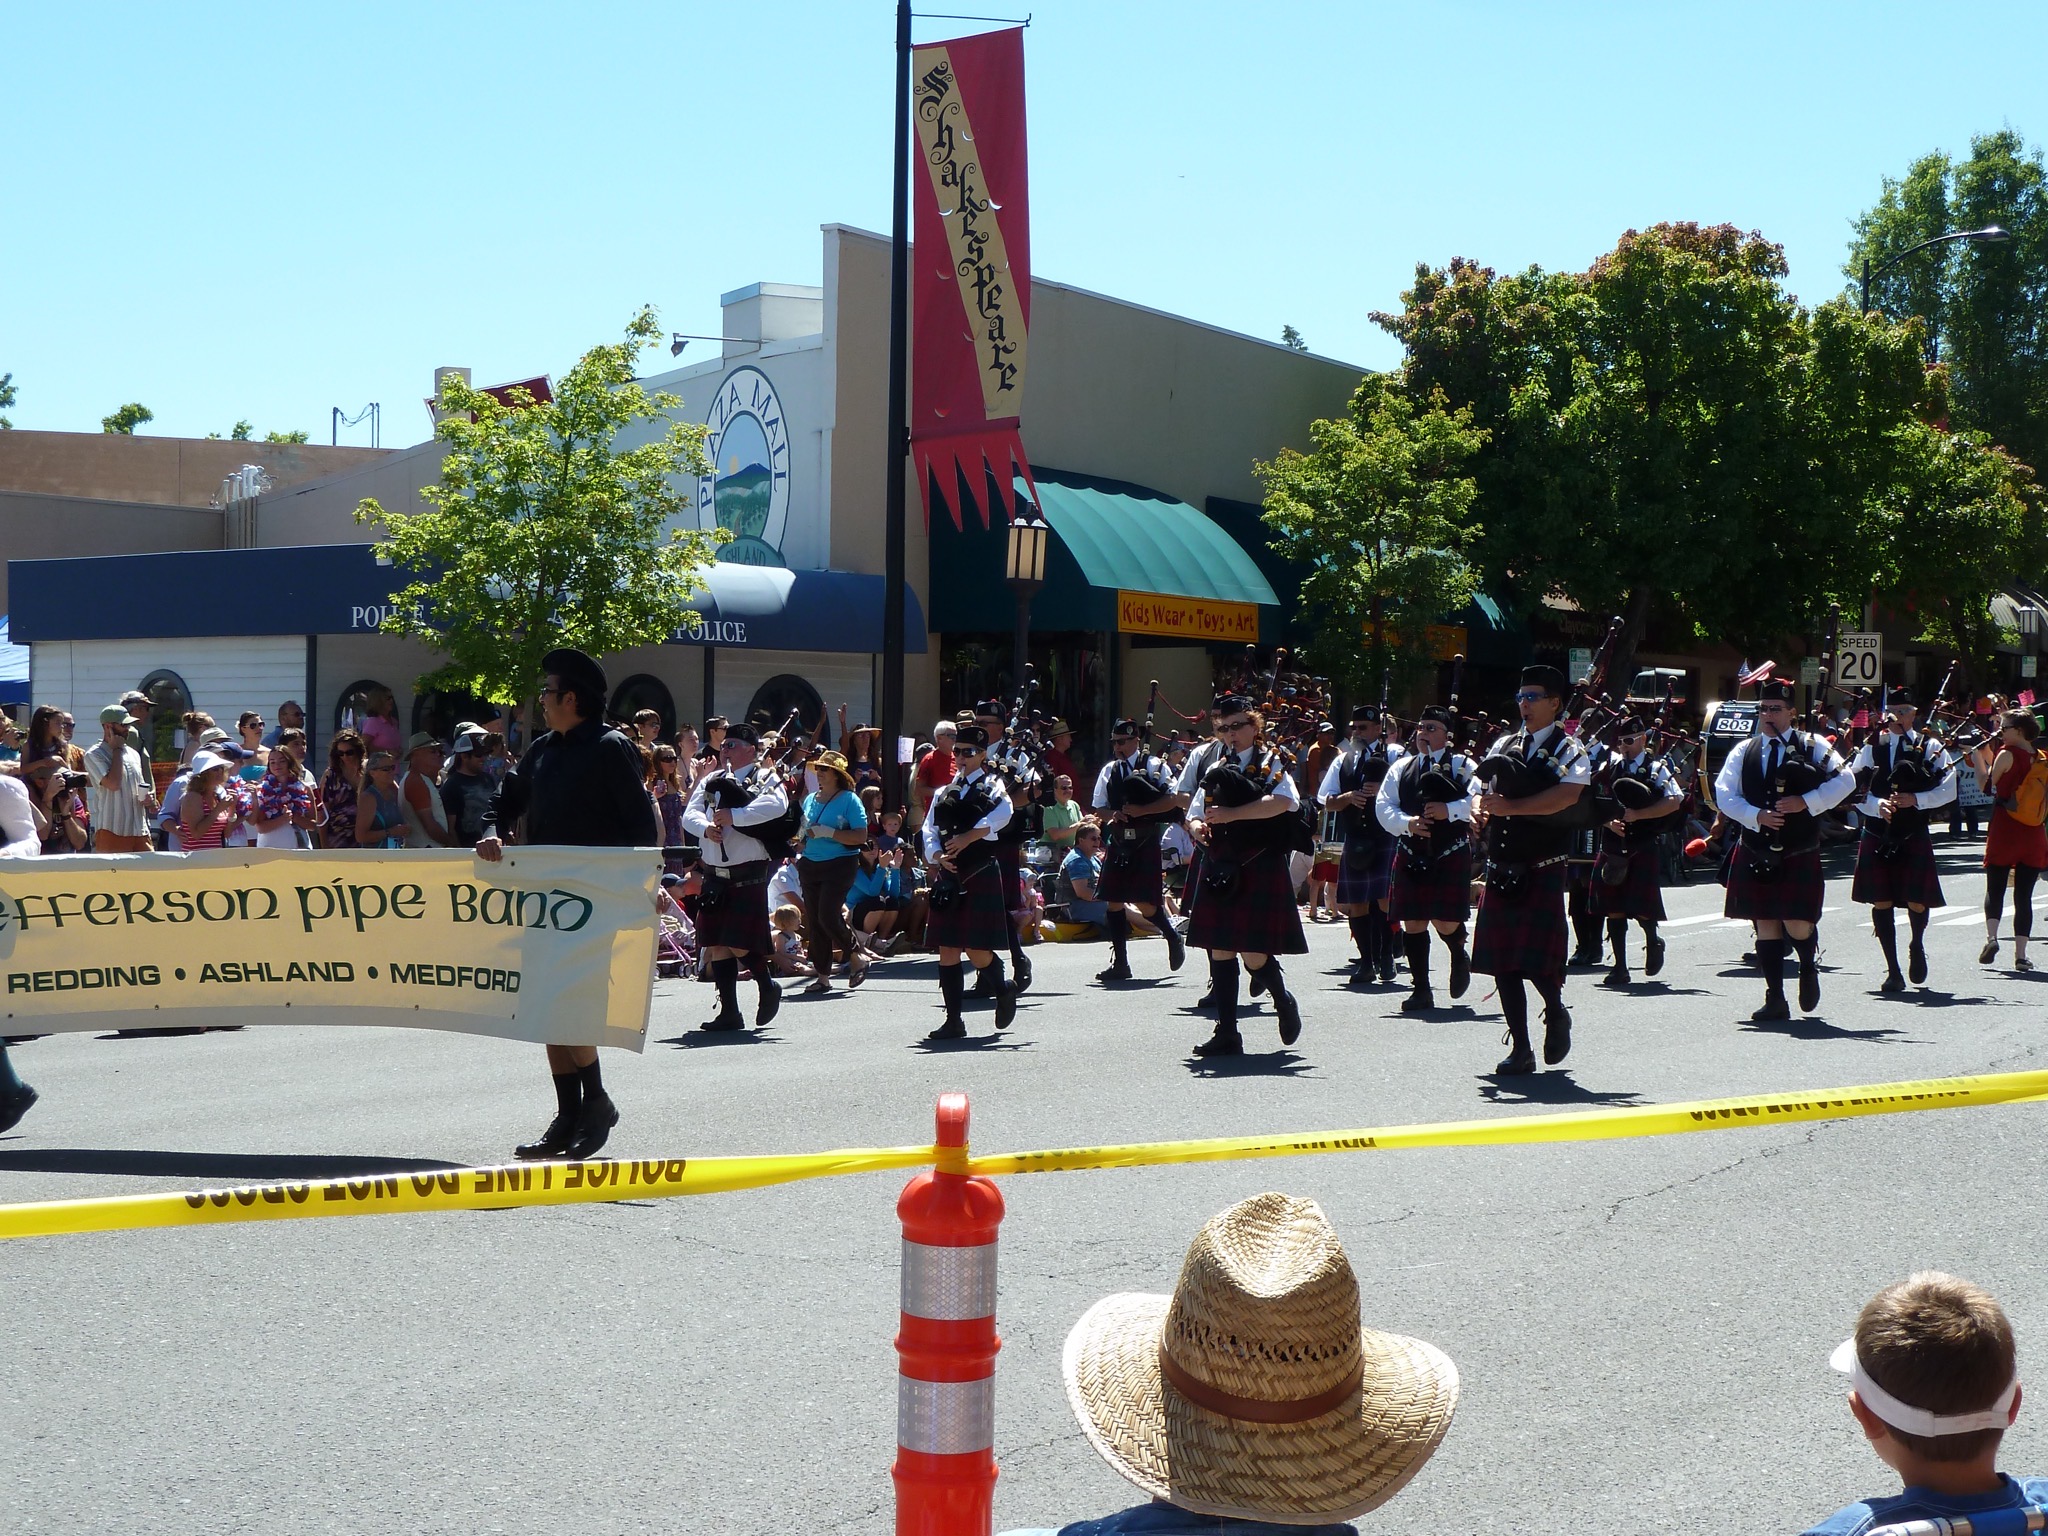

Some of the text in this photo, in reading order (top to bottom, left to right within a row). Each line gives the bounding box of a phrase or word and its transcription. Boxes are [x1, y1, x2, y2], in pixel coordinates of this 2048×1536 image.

[913, 61, 1018, 393] Shakespeare
[701, 379, 787, 510] PLAZA MALL
[725, 546, 767, 566] SHLAND
[351, 605, 425, 628] POLIE
[1122, 601, 1255, 633] Kids Wear Toys Art
[674, 620, 747, 643] POLICE
[1841, 638, 1878, 648] SPEED
[1841, 652, 1878, 680] 20
[1718, 719, 1750, 731] 803
[8, 962, 522, 994] REDDING ASHLAND MEDFORD
